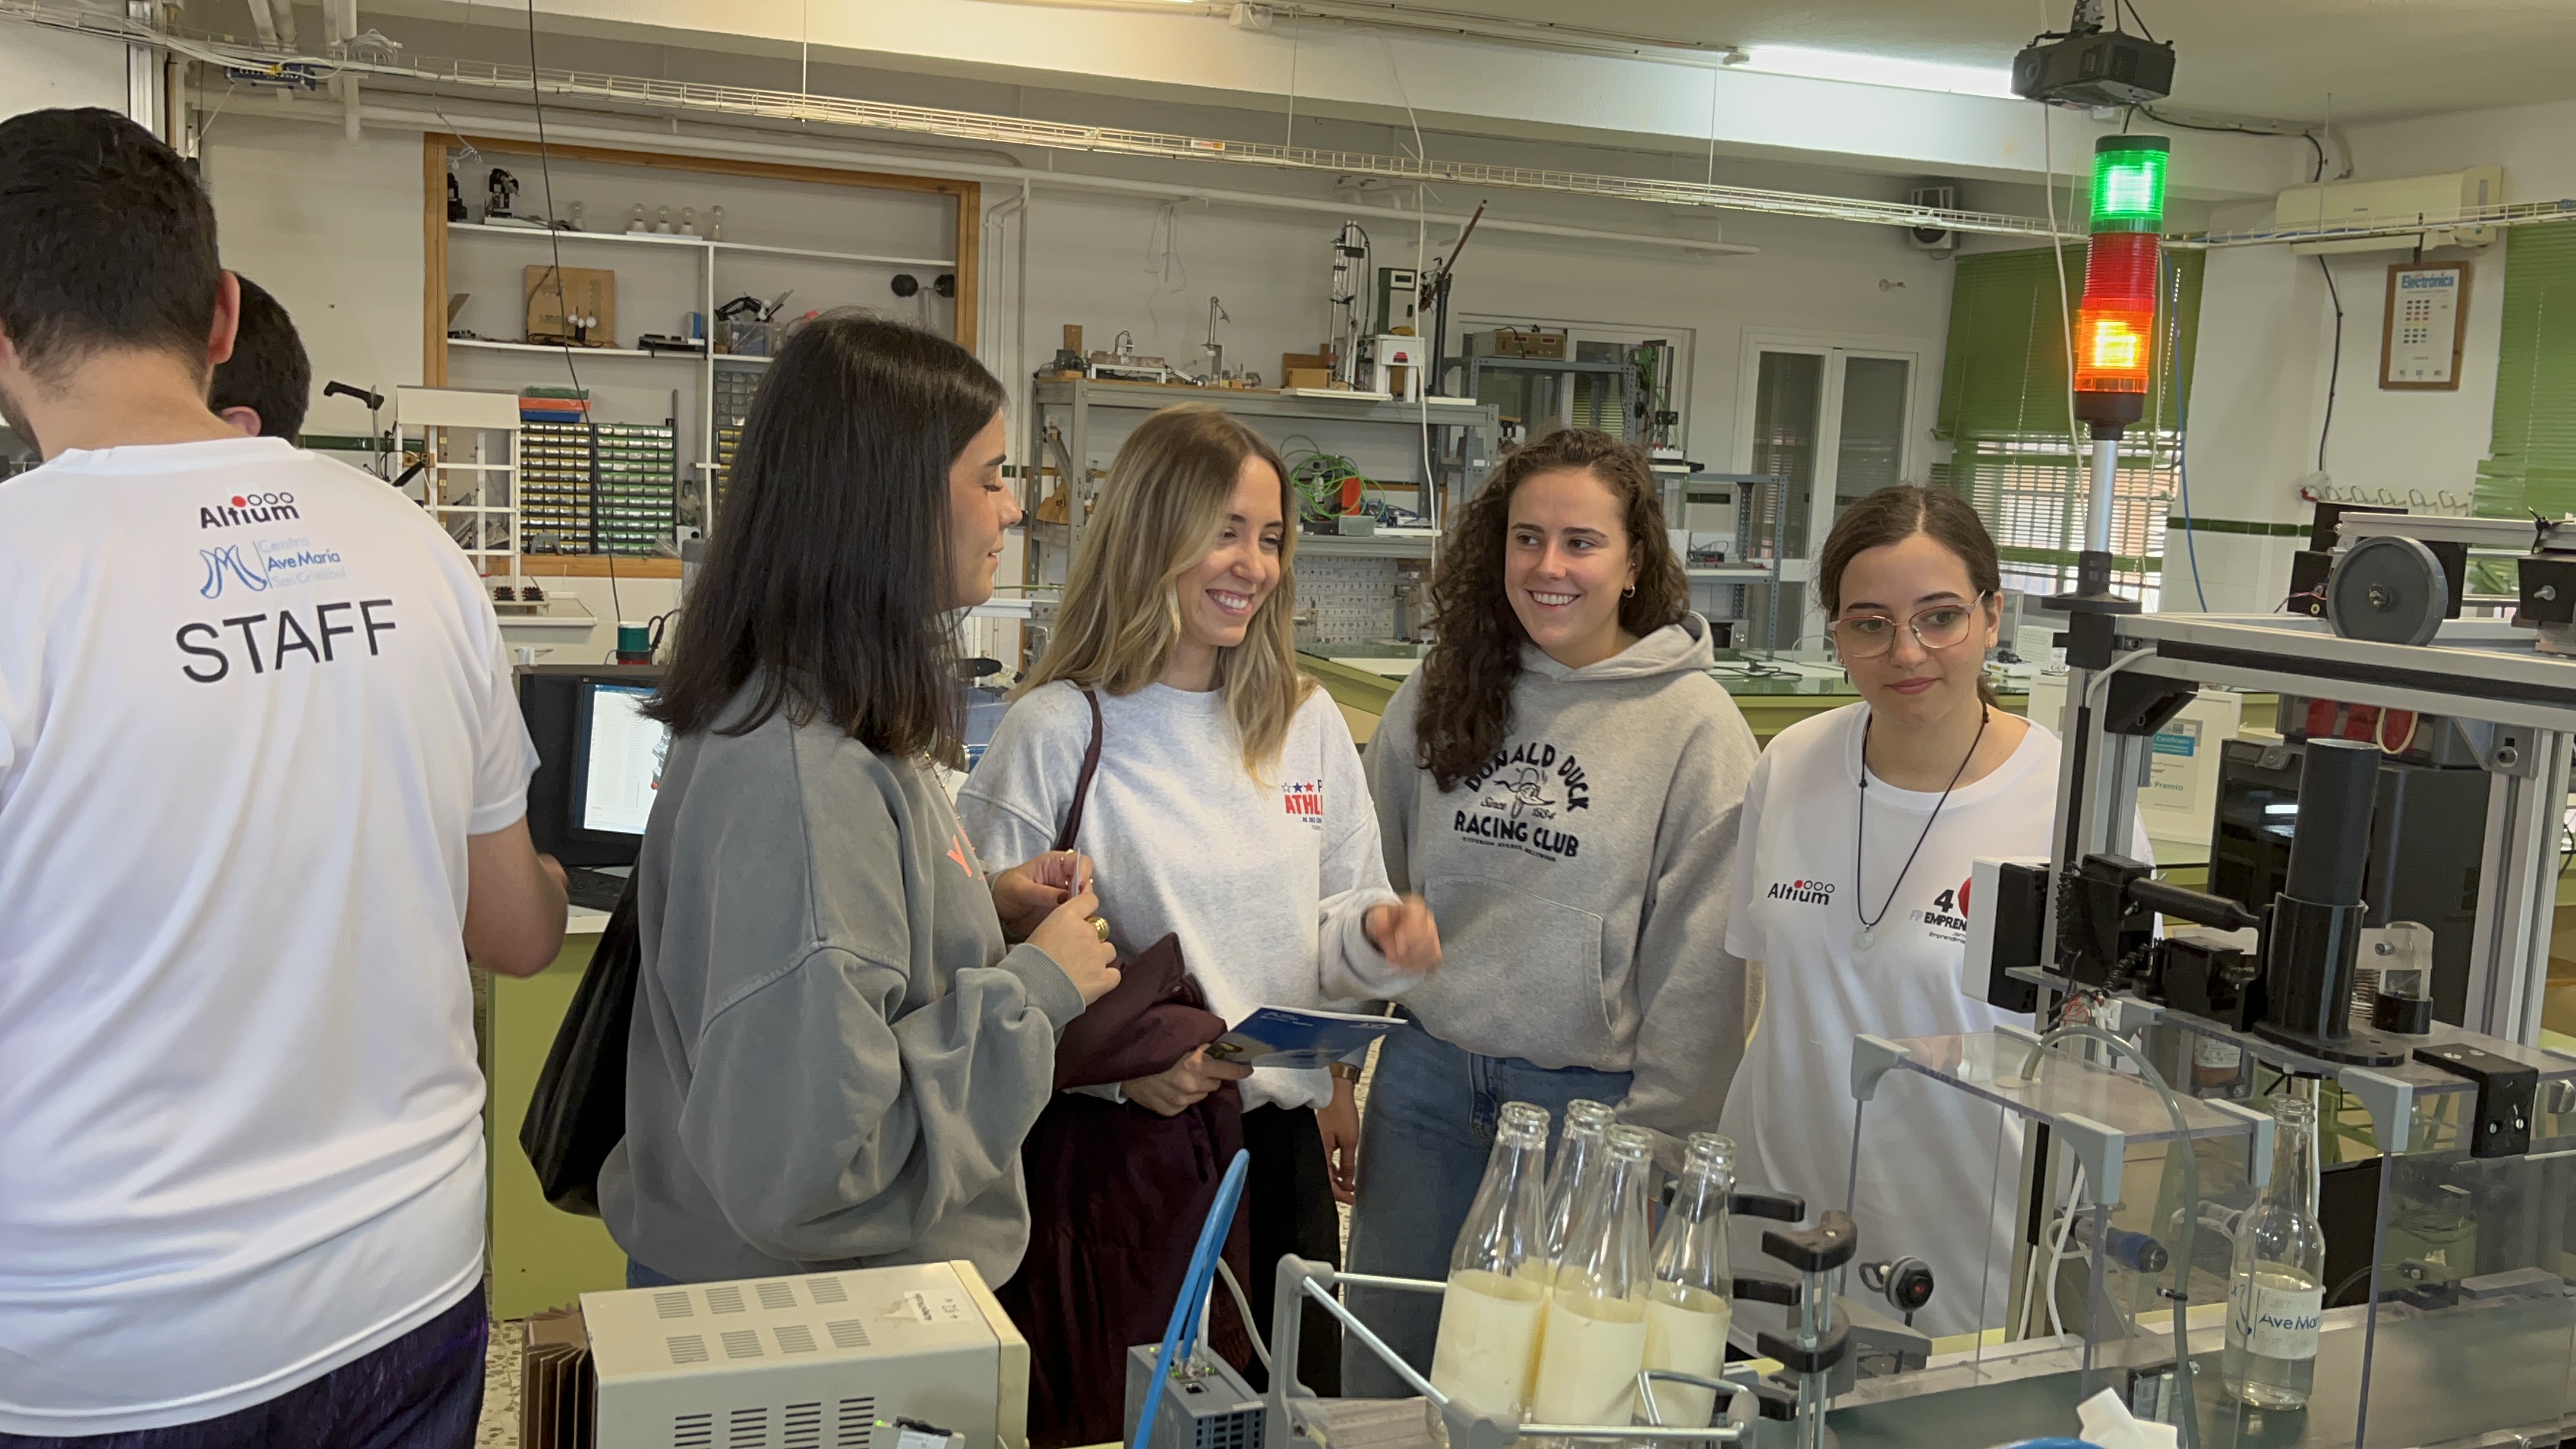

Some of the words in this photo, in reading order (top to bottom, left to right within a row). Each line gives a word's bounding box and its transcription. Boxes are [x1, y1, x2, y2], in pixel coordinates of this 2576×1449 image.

[200, 503, 300, 529] Altium
[257, 537, 310, 554] Centro
[176, 599, 397, 684] STAFF
[1464, 742, 1556, 793] DONALD
[1557, 755, 1590, 812] DUCK
[2154, 781, 2184, 791] Premio
[1454, 809, 1528, 842] RACING
[1534, 827, 1579, 857] CLUB
[1767, 881, 1830, 905] Altium
[1933, 888, 1954, 913] 4
